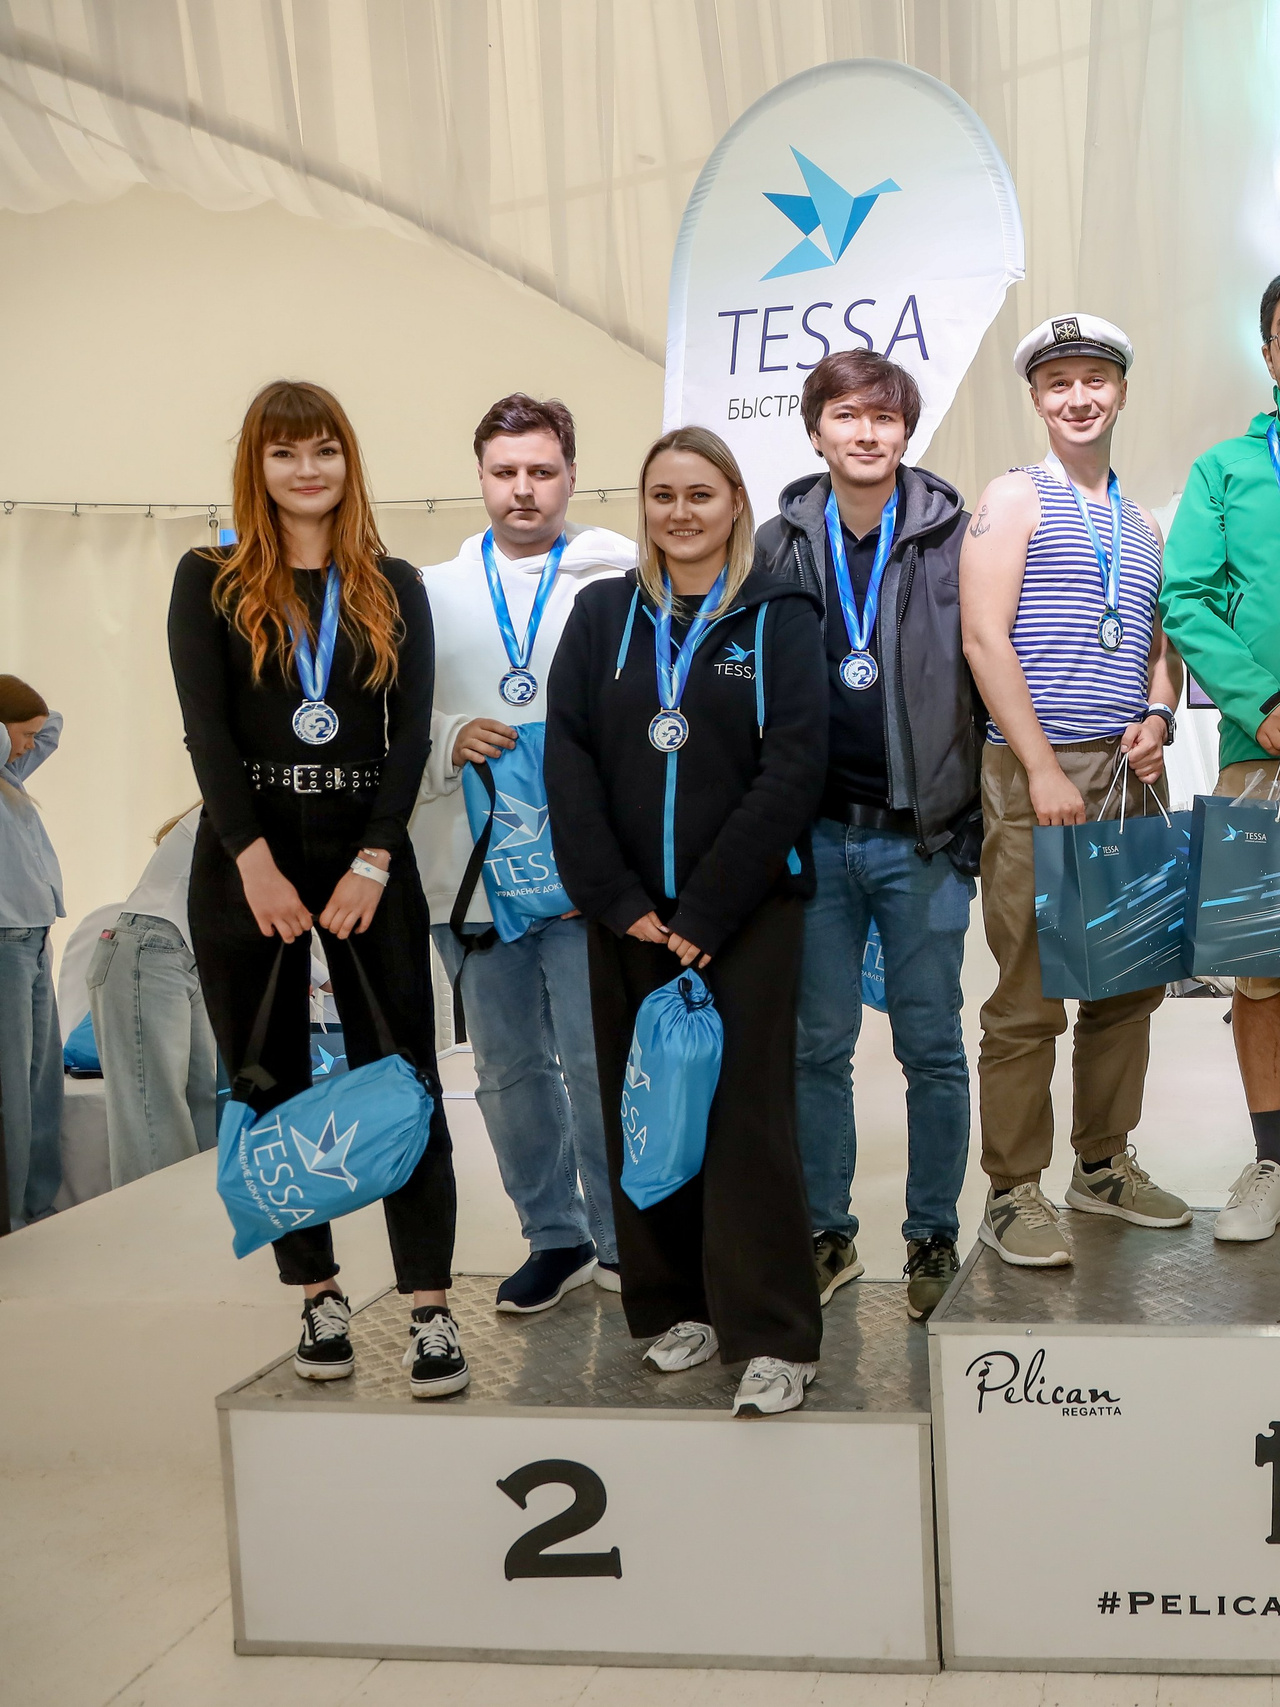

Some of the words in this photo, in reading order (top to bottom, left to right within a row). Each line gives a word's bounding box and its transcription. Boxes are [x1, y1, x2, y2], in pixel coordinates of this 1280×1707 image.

[717, 294, 930, 376] TESSA
[728, 395, 804, 420] БЫСТР
[1102, 845, 1120, 854] TESSA
[1244, 831, 1267, 841] TESSA
[250, 1114, 316, 1227] TESSA
[965, 1348, 1121, 1414] Pelican
[1062, 1406, 1122, 1417] REGATTA
[496, 1458, 623, 1581] 2
